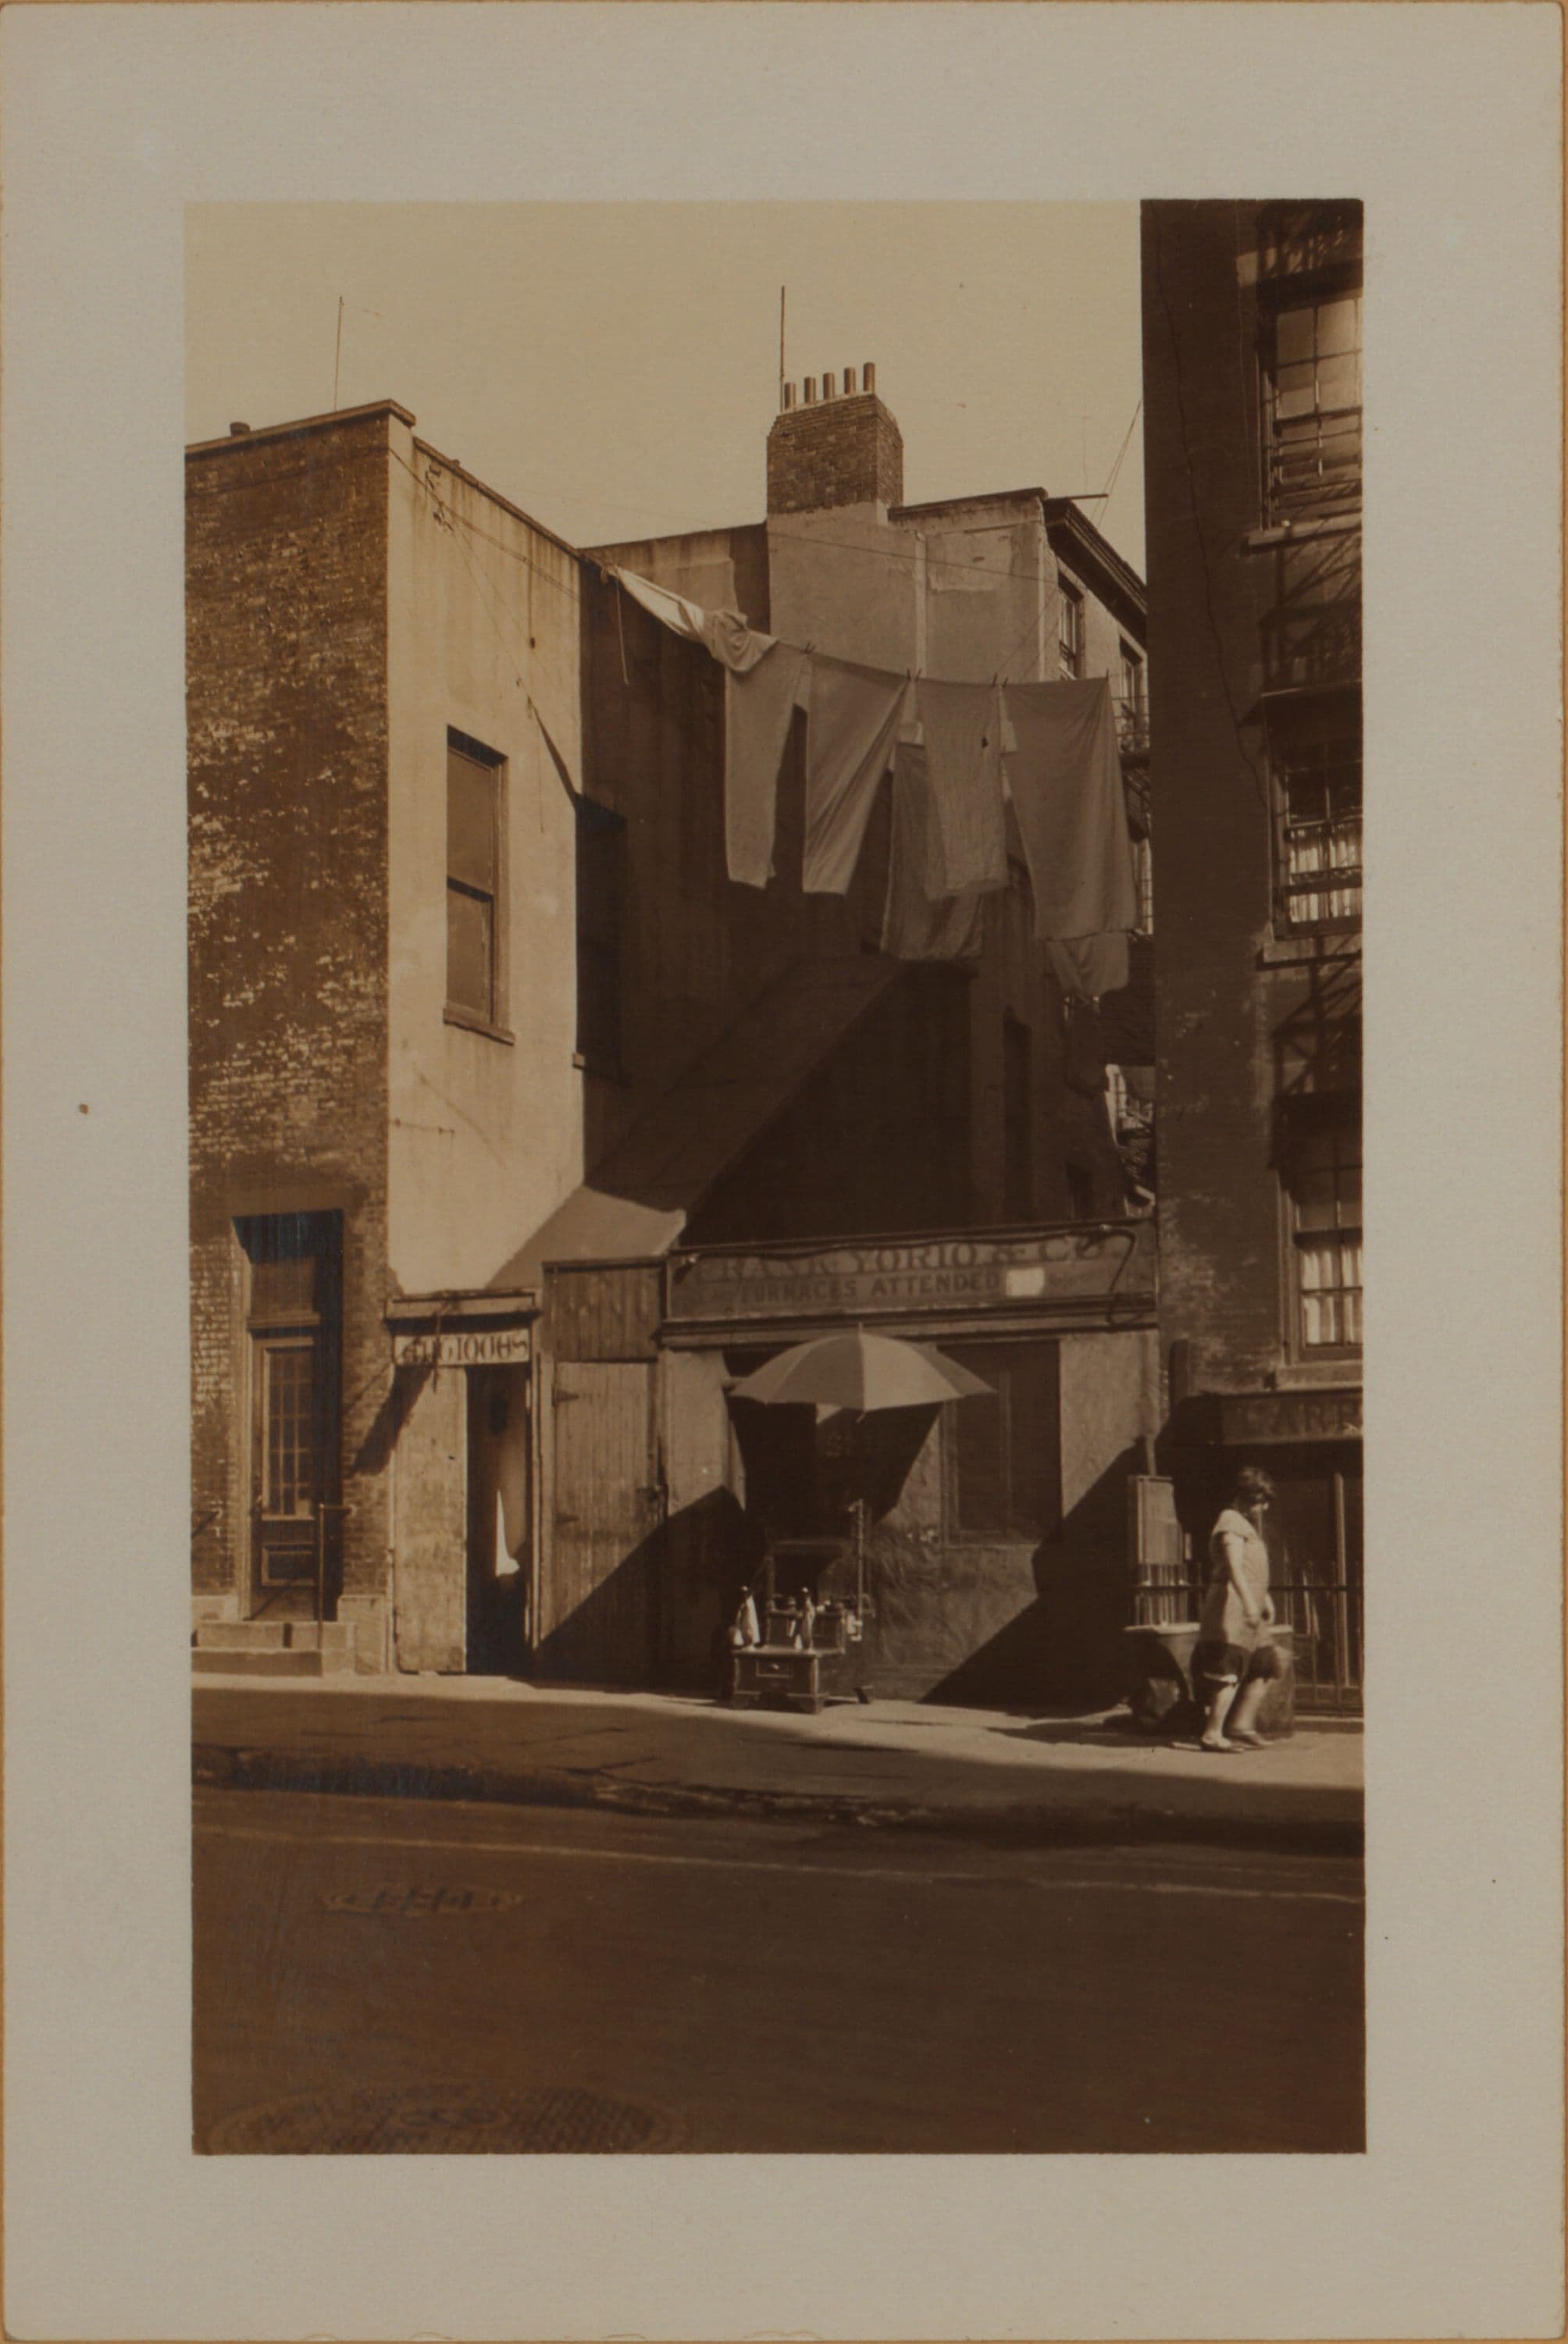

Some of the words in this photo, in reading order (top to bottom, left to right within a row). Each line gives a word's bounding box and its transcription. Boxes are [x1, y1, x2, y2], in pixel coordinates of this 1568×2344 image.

[854, 1244, 978, 1274] YORIO
[743, 1278, 857, 1303] FURNACES
[871, 1272, 998, 1297] ATTENDED
